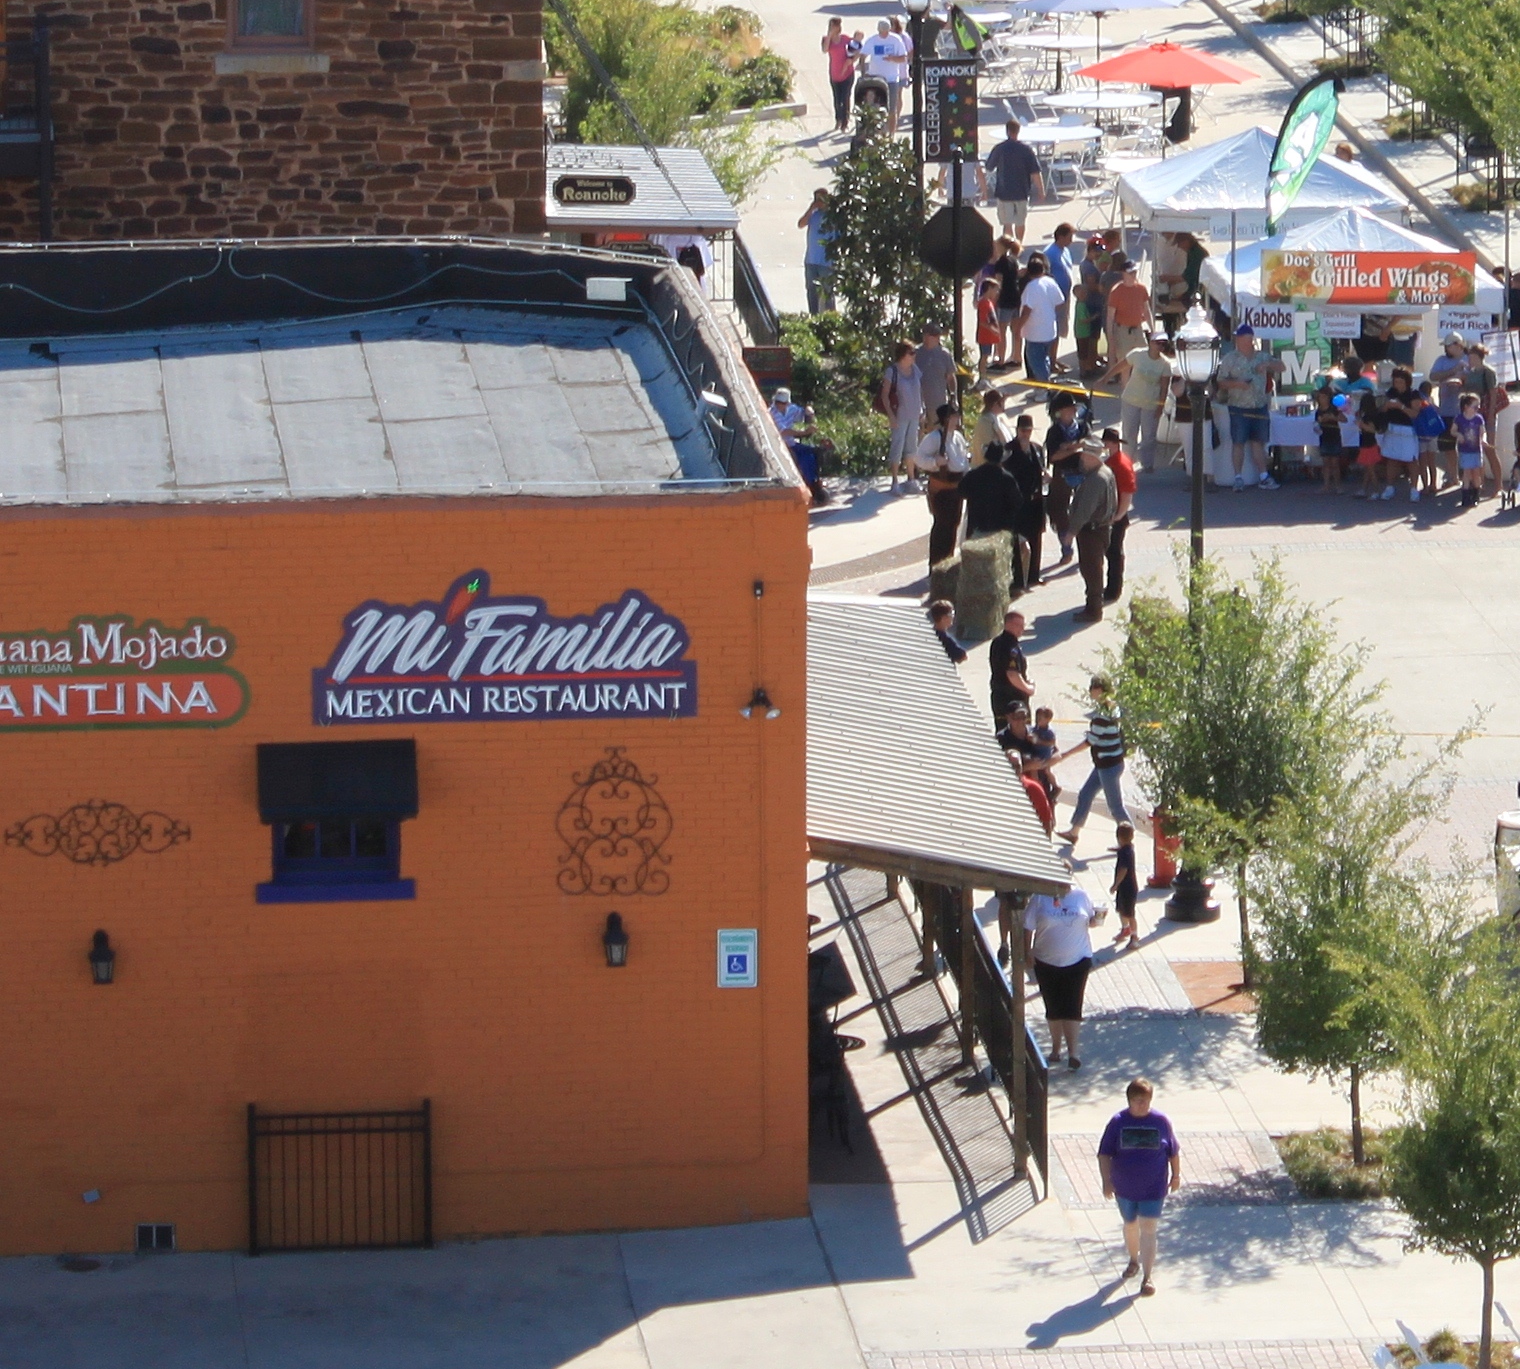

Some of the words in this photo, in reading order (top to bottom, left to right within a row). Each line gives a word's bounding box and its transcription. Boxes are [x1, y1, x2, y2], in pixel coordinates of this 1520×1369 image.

[925, 65, 976, 76] ROANOKE
[926, 75, 941, 156] CELEBRATE
[562, 186, 627, 202] Roanoke
[1283, 253, 1320, 267] Doc's
[1324, 253, 1357, 267] Grill
[1310, 266, 1382, 288] Grilled
[1388, 267, 1450, 292] Wings
[1396, 291, 1407, 304] &
[1410, 292, 1447, 304] More
[1244, 307, 1292, 329] Kabobs
[1440, 320, 1465, 330] Fried
[1467, 320, 1491, 330] Rice
[77, 623, 228, 670] Mojado
[332, 608, 452, 685] Mi
[447, 597, 684, 682] Familia
[8, 665, 28, 673] WET
[31, 664, 73, 673] IGUANA
[325, 686, 471, 719] MEXICAN
[482, 682, 687, 714] RESTAURANT
